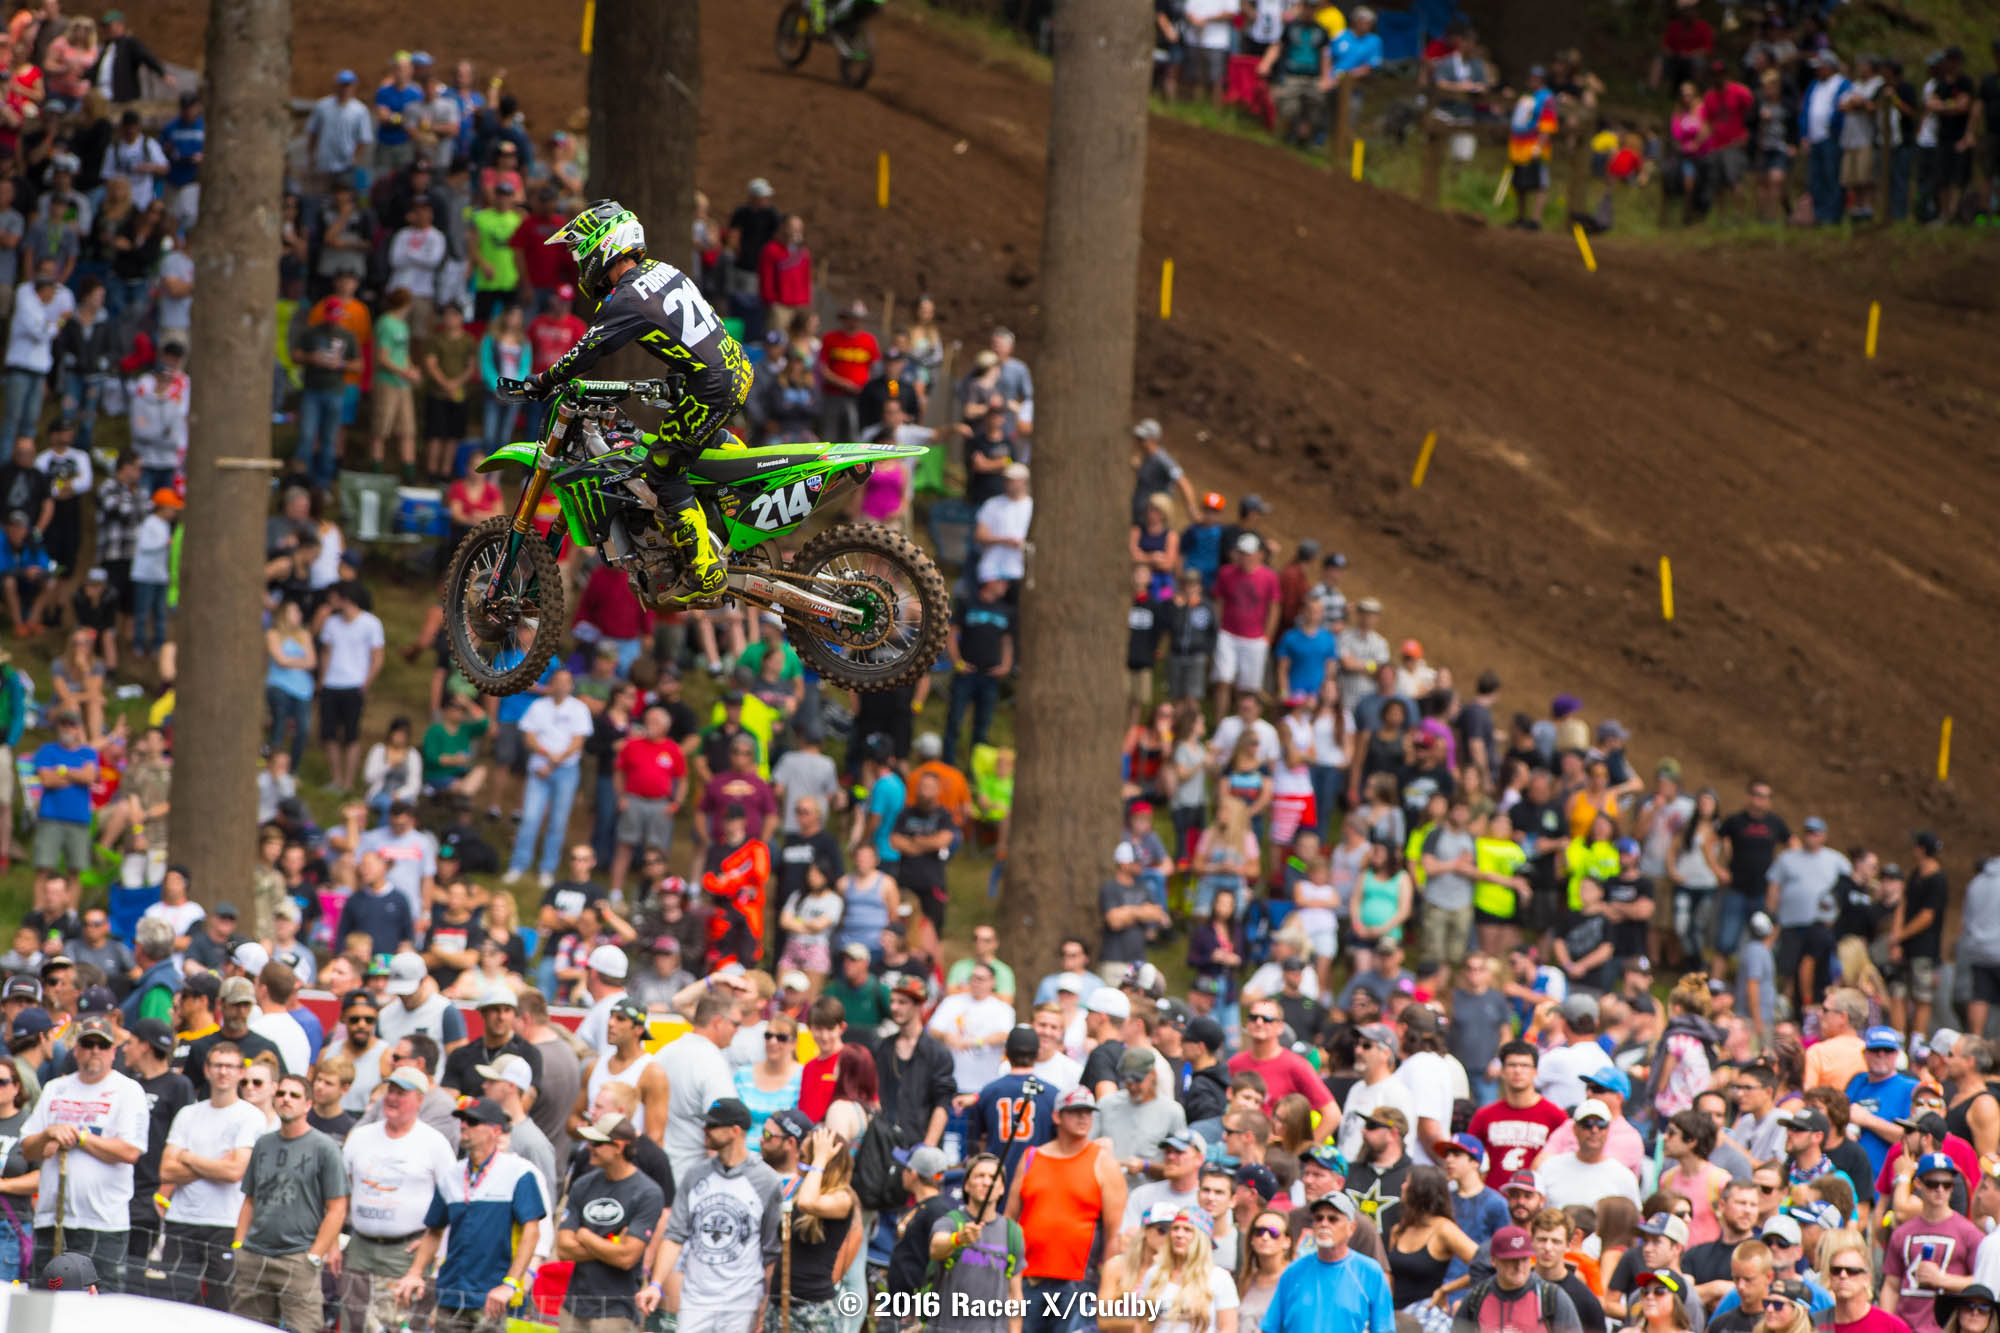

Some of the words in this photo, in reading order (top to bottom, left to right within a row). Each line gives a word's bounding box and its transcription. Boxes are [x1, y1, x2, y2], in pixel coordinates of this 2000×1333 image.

[585, 381, 629, 391] RENTHAL
[757, 457, 789, 469] Kawasaki
[751, 480, 812, 531] 214
[996, 1097, 1036, 1142] 13
